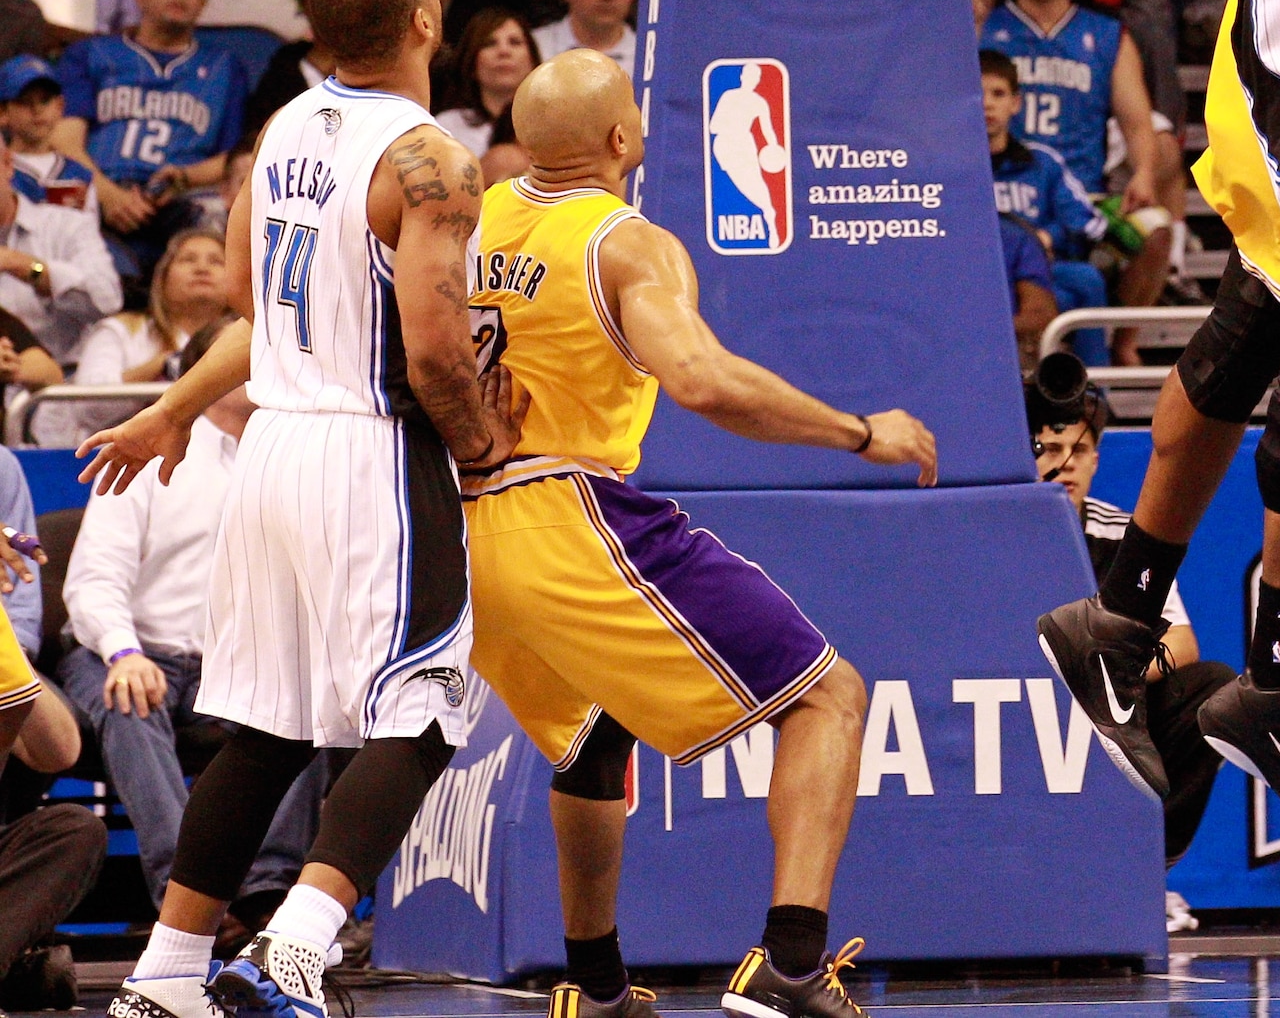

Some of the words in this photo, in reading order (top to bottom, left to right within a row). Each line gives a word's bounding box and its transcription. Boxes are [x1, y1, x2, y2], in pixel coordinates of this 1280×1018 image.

[97, 85, 211, 136] ORLANDO
[1024, 91, 1061, 136] 12
[120, 118, 171, 165] 12
[807, 144, 908, 169] Where
[808, 178, 943, 208] amazing
[718, 214, 766, 241] NBA
[809, 215, 946, 245] happens.
[263, 216, 320, 355] 14
[469, 253, 547, 301] ISHER
[702, 680, 935, 799] NA
[952, 677, 1094, 795] TV
